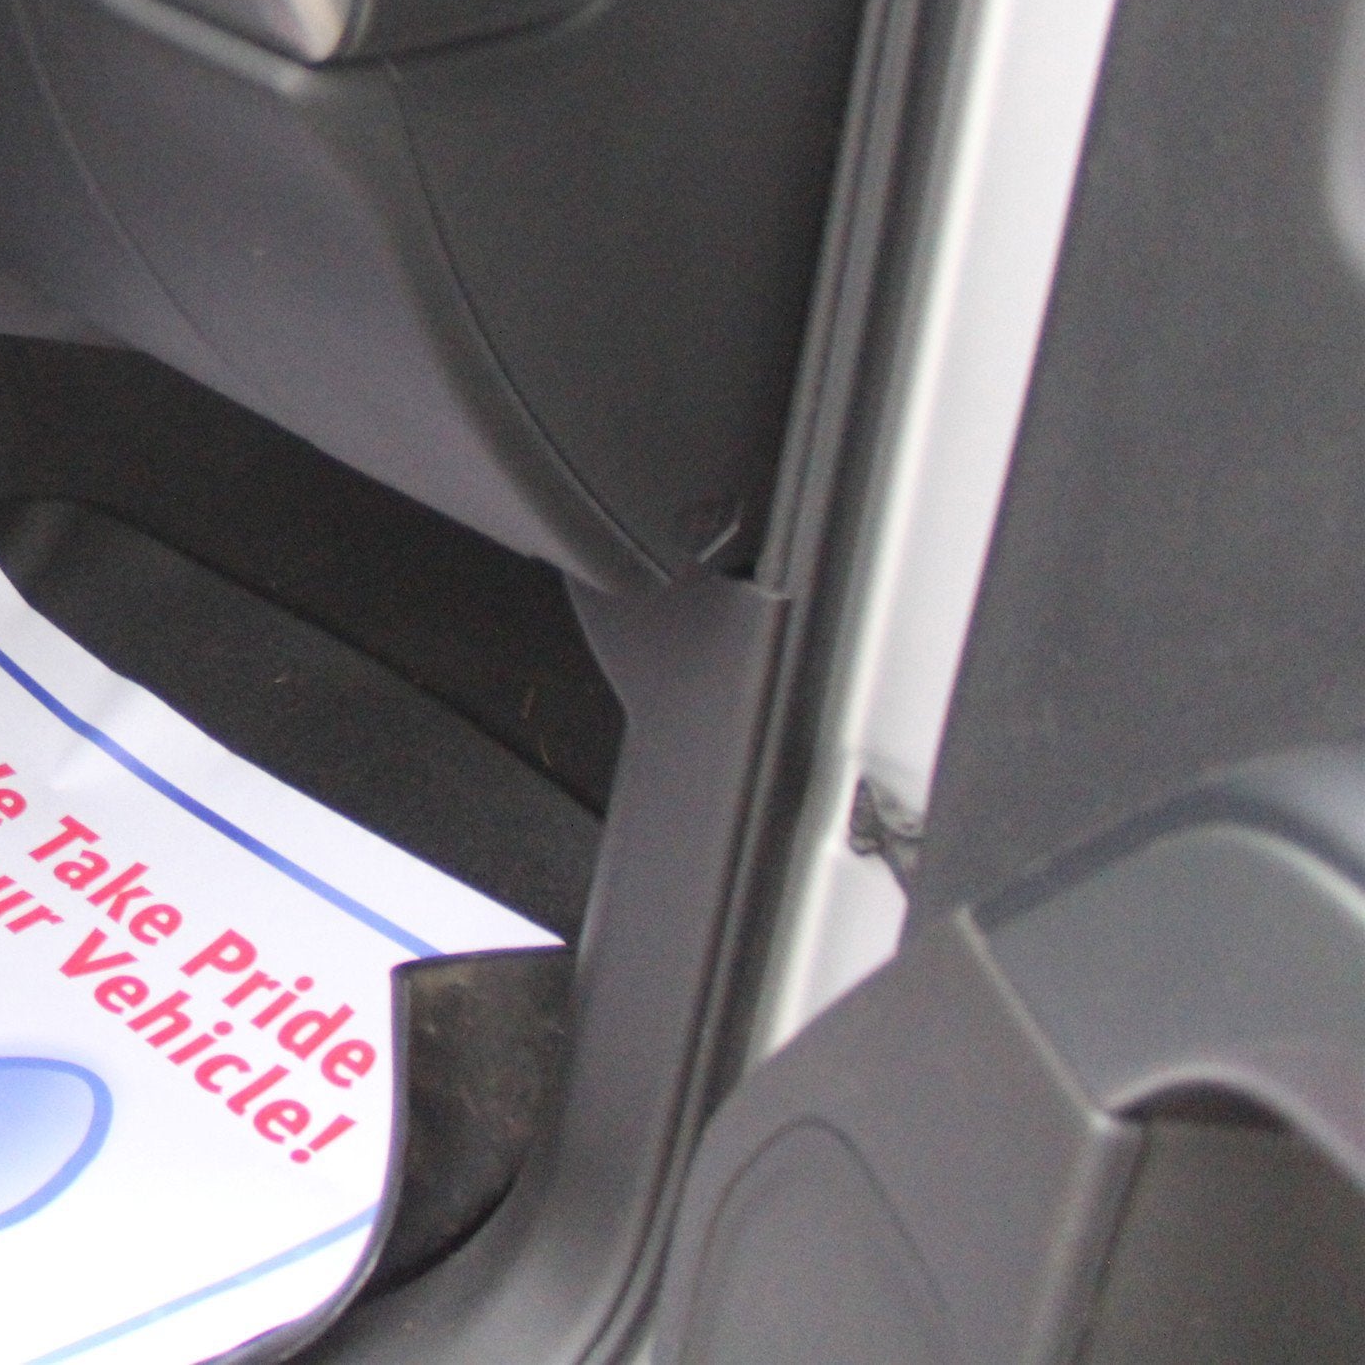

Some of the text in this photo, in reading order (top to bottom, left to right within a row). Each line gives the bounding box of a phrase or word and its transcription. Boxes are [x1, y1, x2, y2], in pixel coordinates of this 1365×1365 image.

[29, 816, 182, 945] Take
[180, 929, 377, 1089] Pride
[59, 929, 358, 1165] Vehicle!
